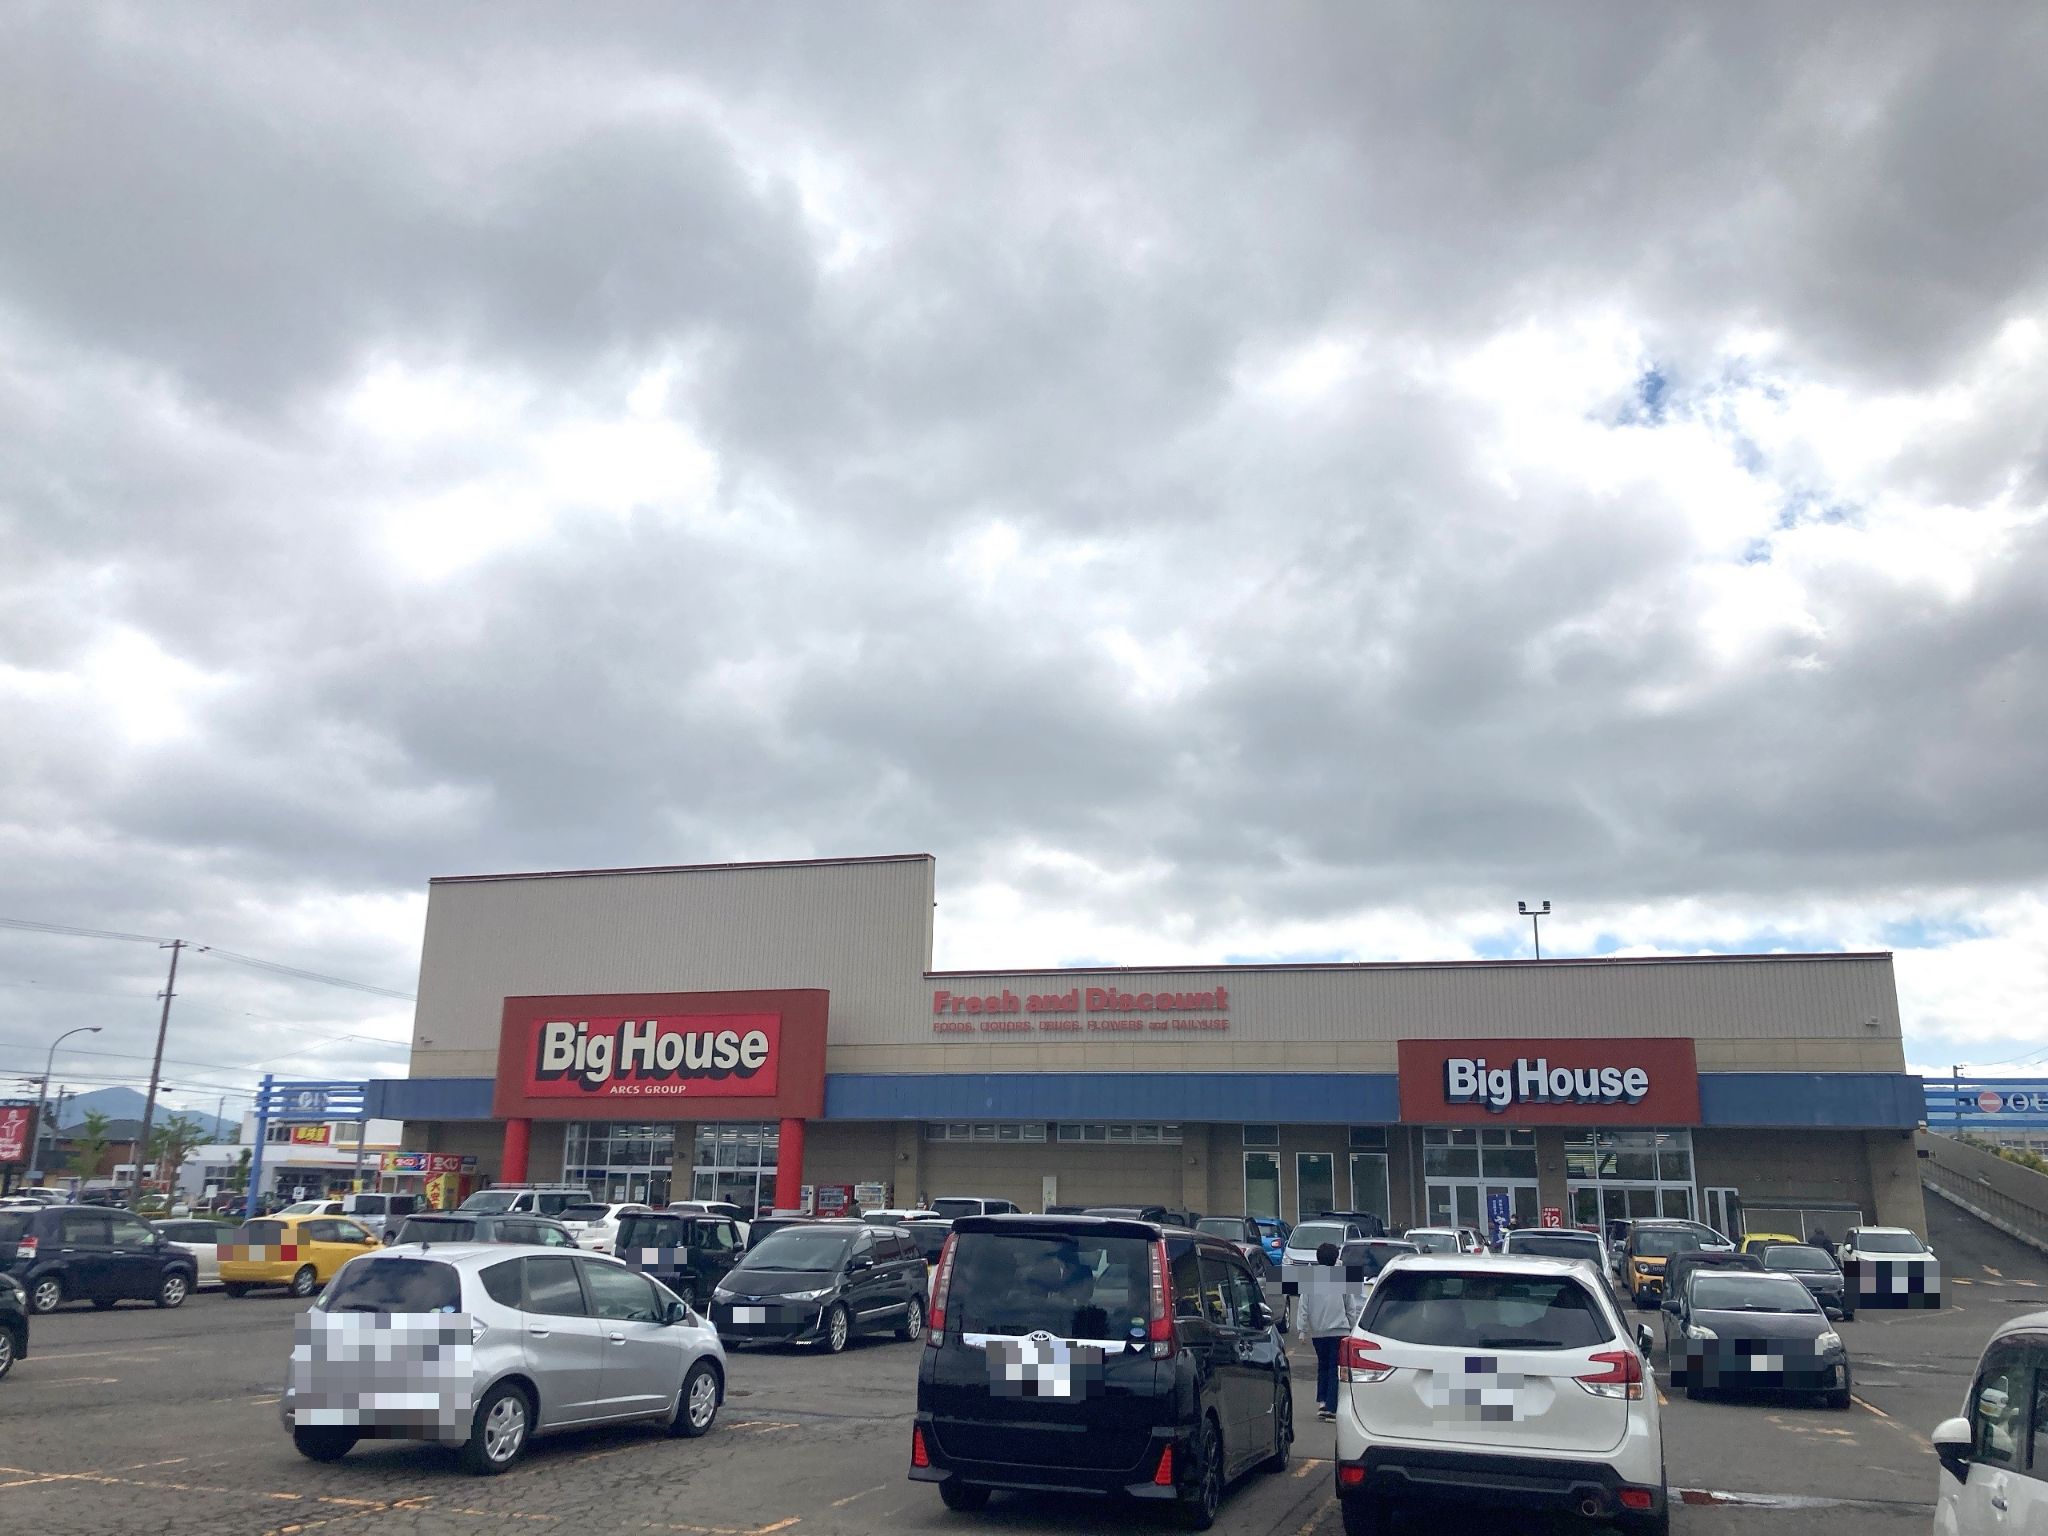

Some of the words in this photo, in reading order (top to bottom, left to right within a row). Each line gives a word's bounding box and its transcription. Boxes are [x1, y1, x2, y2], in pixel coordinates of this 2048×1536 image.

[934, 989, 1020, 1014] Fresh
[1026, 988, 1079, 1012] and
[1086, 986, 1229, 1012] Discount
[541, 1021, 615, 1083] Big
[619, 1020, 769, 1071] House
[610, 1085, 640, 1094] ARCS
[645, 1085, 686, 1094] GROUP
[1446, 1058, 1513, 1106] Big
[1516, 1058, 1649, 1097] House
[433, 1156, 459, 1170] 宝くじ
[1545, 1216, 1560, 1227] 12
